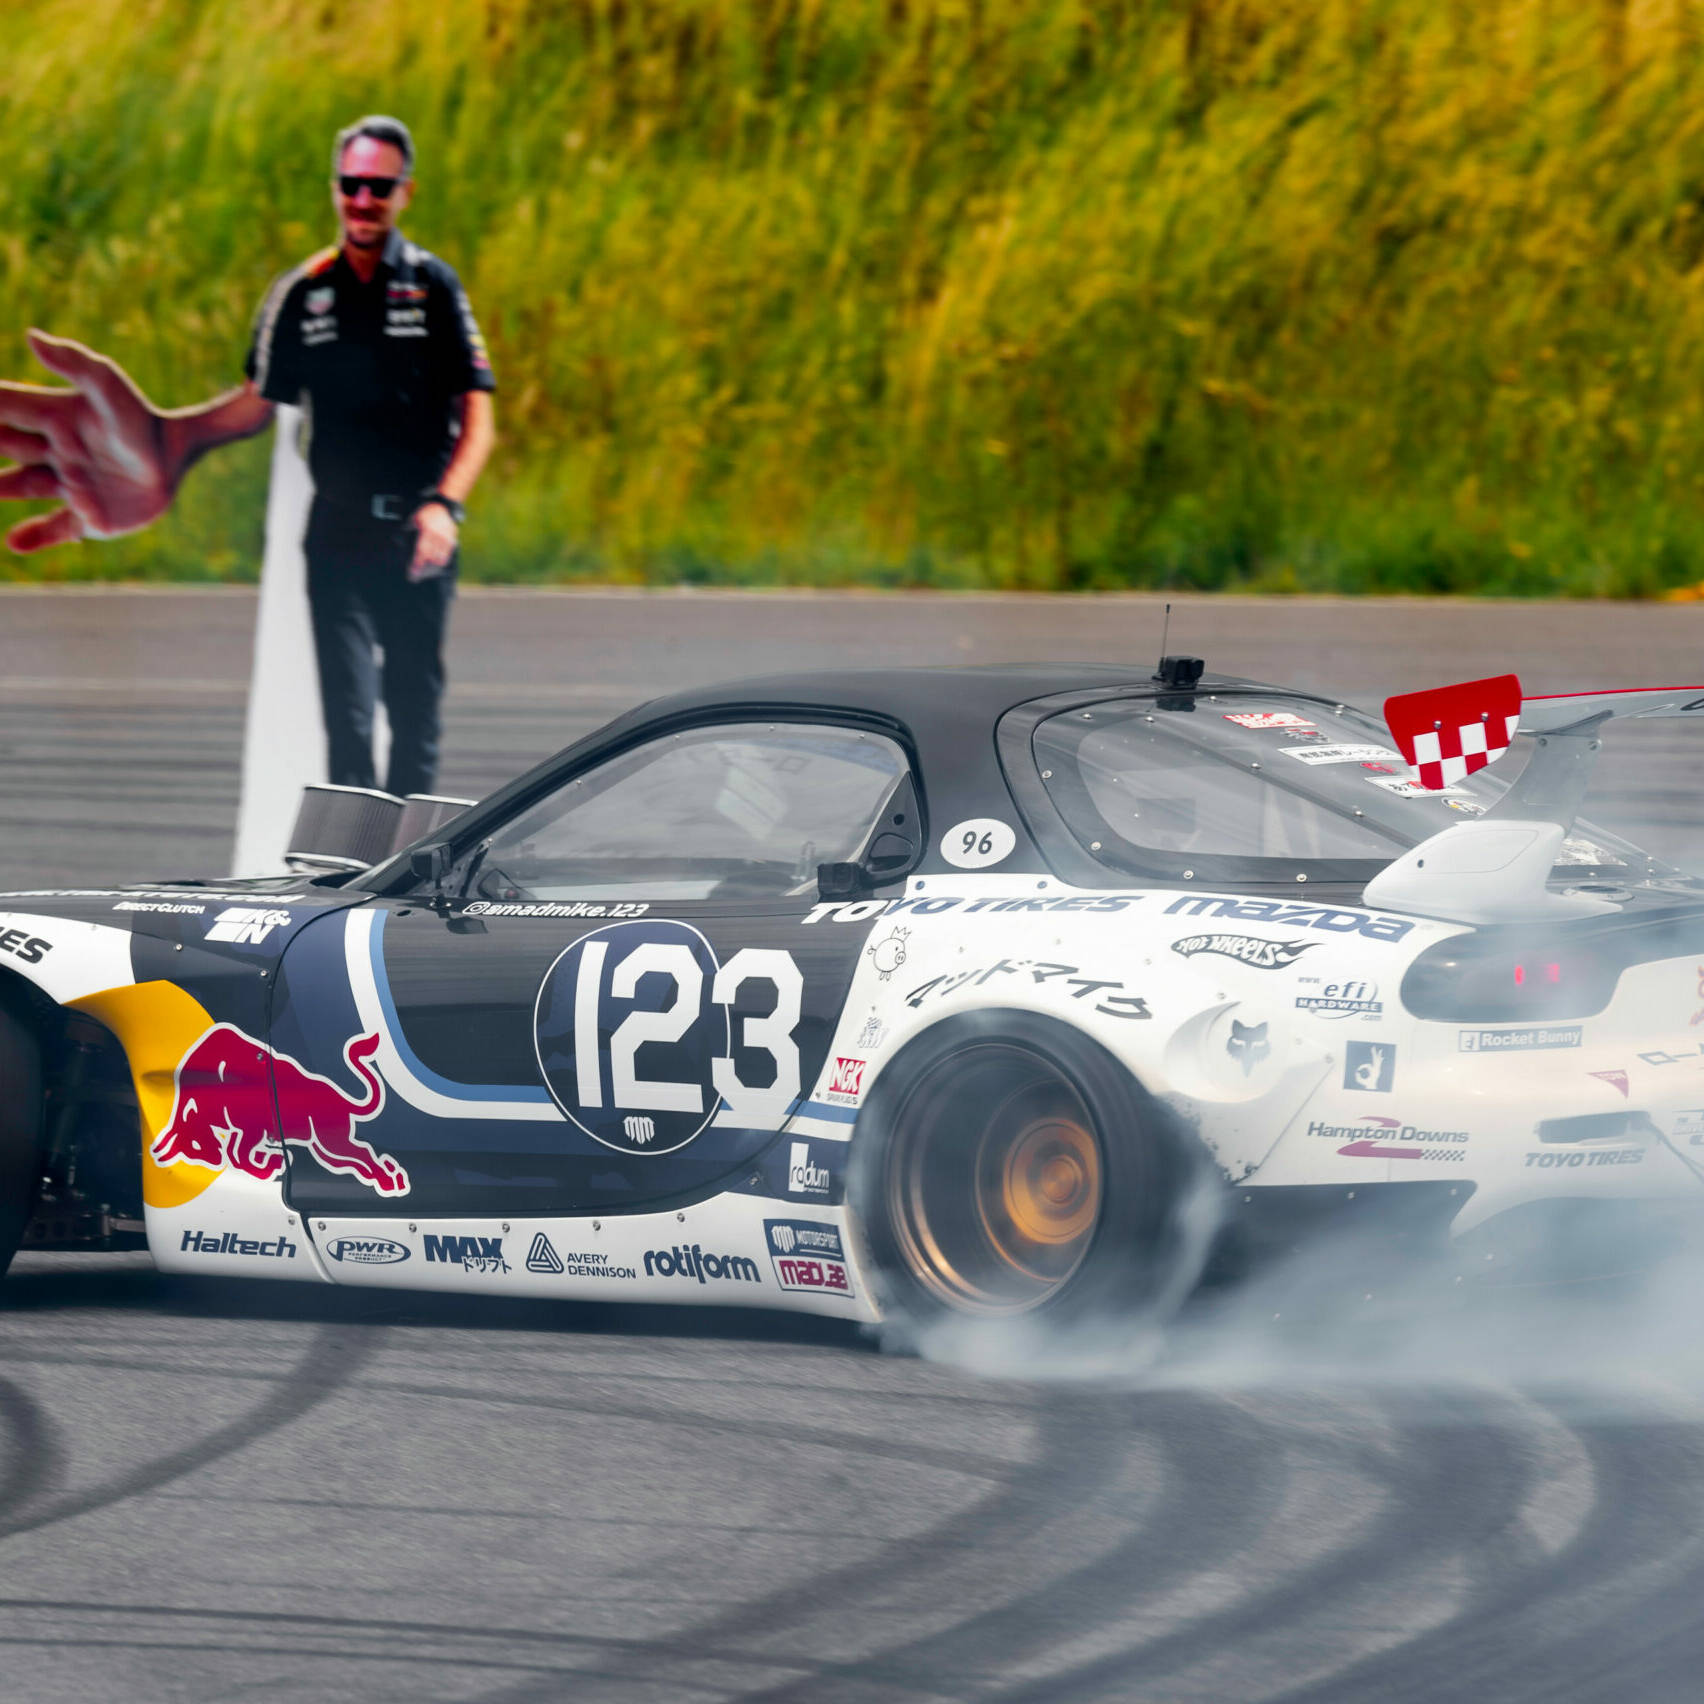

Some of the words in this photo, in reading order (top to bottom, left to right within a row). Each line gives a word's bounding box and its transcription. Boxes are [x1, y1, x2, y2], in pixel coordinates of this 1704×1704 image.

[962, 831, 993, 855] 96
[800, 897, 965, 924] TOYO
[963, 895, 1146, 913] TIRES
[0, 926, 54, 965] ES
[1323, 981, 1368, 999] efi
[1298, 999, 1379, 1011] HARDWARE
[574, 940, 804, 1115] 123
[1481, 1031, 1535, 1047] Rocket
[1537, 1030, 1580, 1045] Bunny
[831, 1059, 864, 1092] NGK
[1307, 1121, 1398, 1143] Hampton
[1400, 1126, 1469, 1144] Downs
[1524, 1151, 1586, 1168] TOYO
[1587, 1149, 1646, 1165] TIRES
[180, 1230, 297, 1258] Haltech
[423, 1234, 503, 1264] MAX
[463, 1258, 512, 1275] ドリフト
[567, 1253, 609, 1265] AVERY
[643, 1244, 762, 1285] rotiform
[568, 1265, 637, 1279] DENNISON
